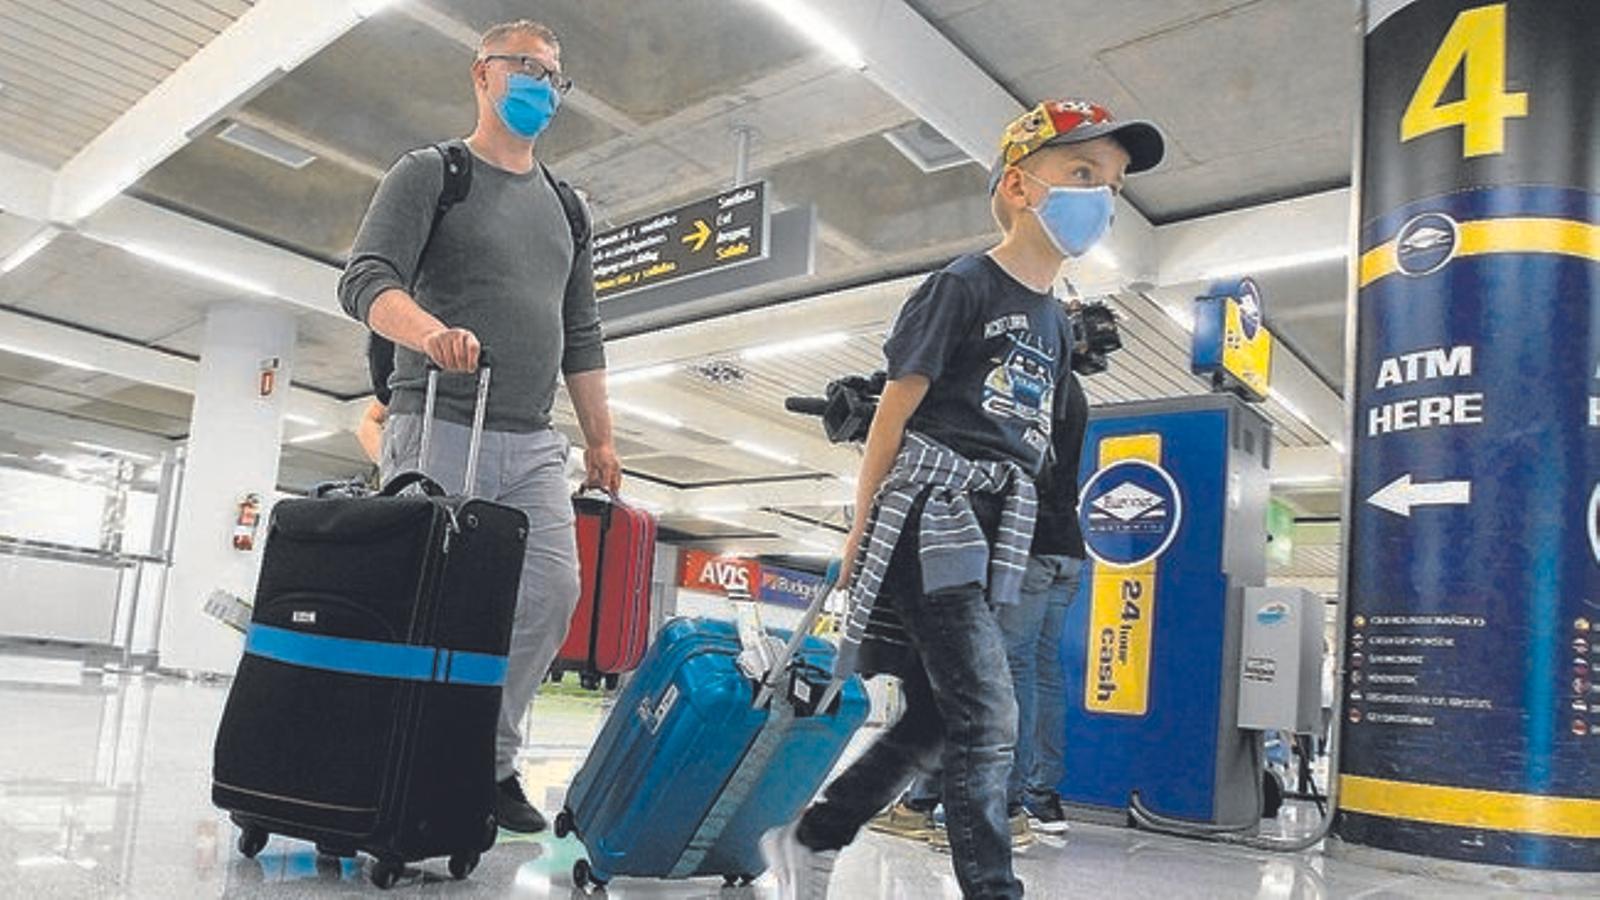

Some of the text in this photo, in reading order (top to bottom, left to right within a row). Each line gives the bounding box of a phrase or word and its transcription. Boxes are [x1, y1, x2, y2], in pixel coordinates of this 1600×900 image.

[1401, 3, 1528, 158] 4
[1376, 346, 1472, 389] ATM
[1368, 393, 1483, 436] HERE
[700, 561, 750, 588] AVIS
[1121, 580, 1142, 621] 24
[1097, 627, 1117, 701] cash
